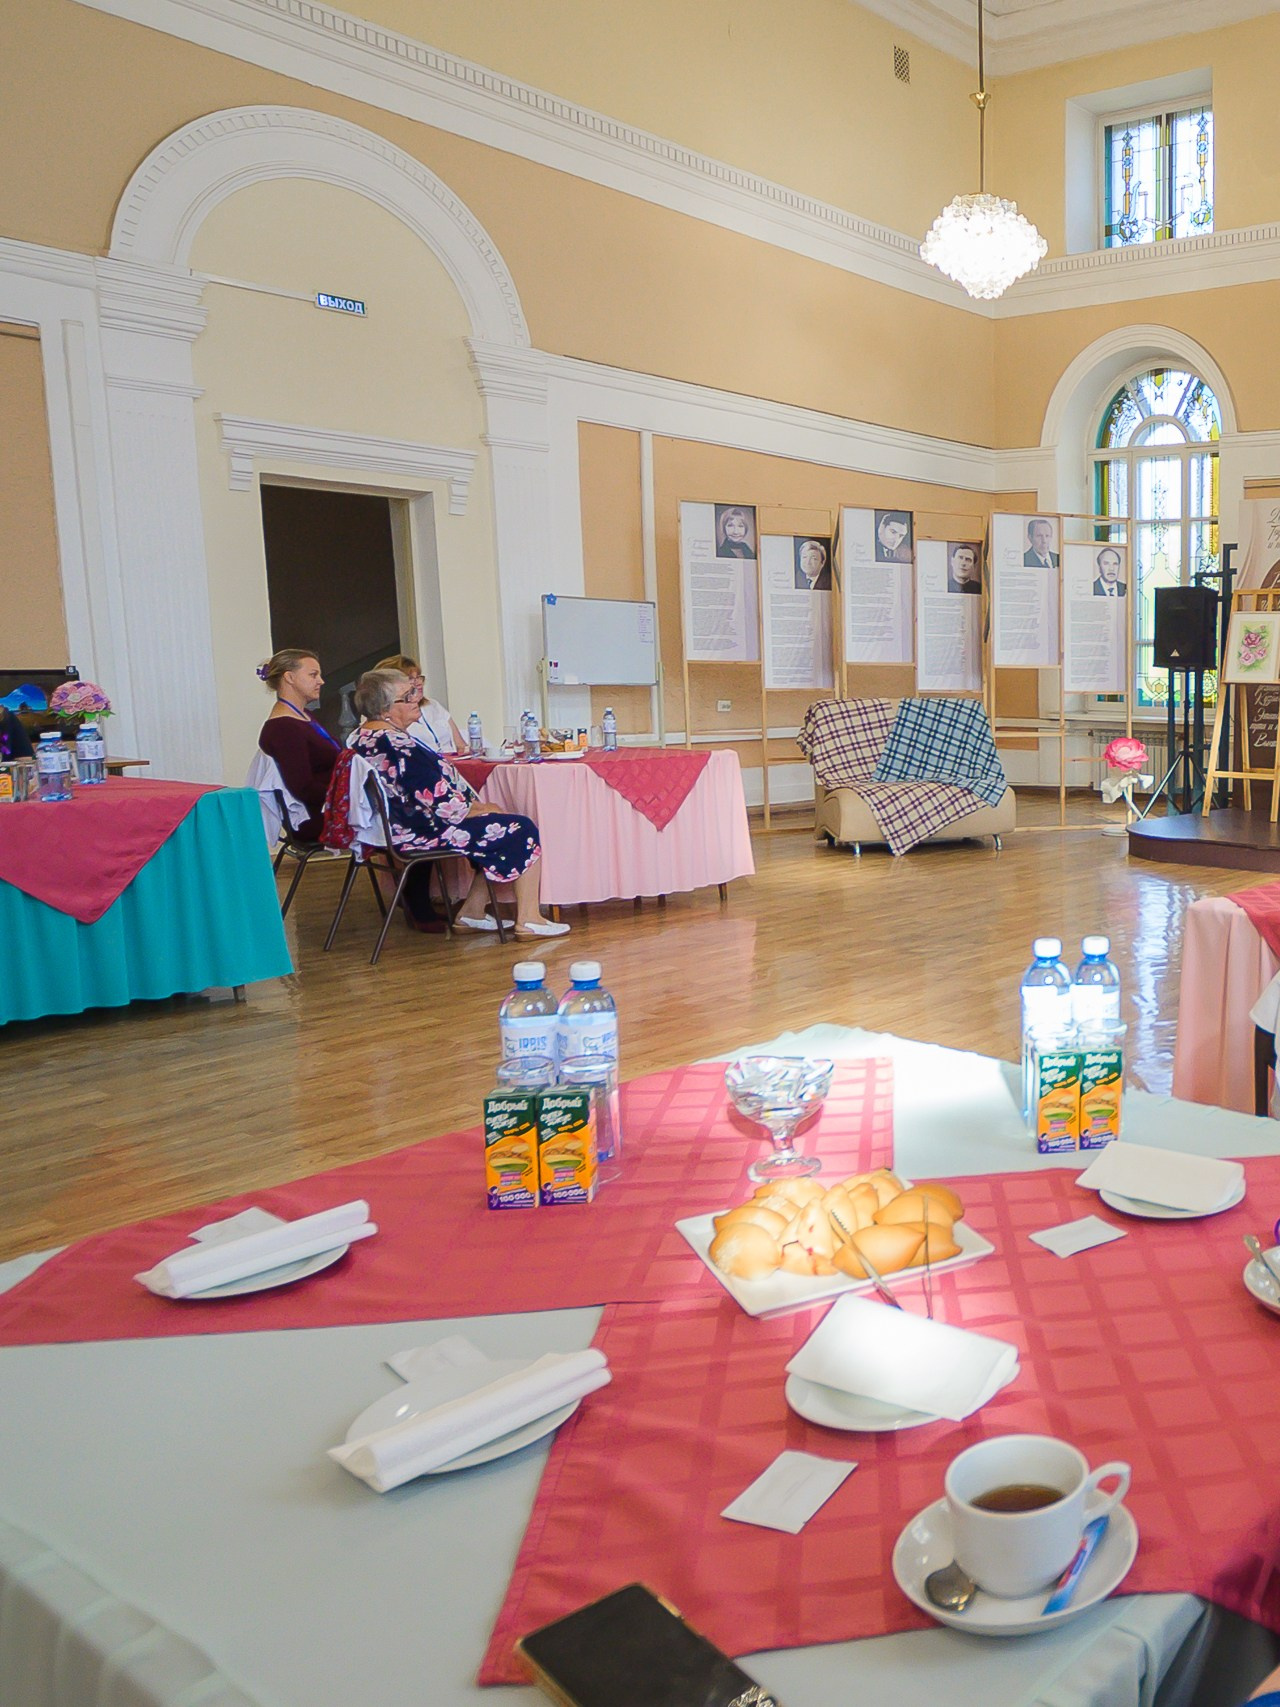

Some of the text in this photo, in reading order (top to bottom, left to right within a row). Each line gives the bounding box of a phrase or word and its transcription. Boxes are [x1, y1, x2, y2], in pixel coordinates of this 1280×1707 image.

[319, 294, 364, 314] ВЫХОД
[488, 1100, 528, 1113] Добрый
[542, 1097, 583, 1110] Добрый
